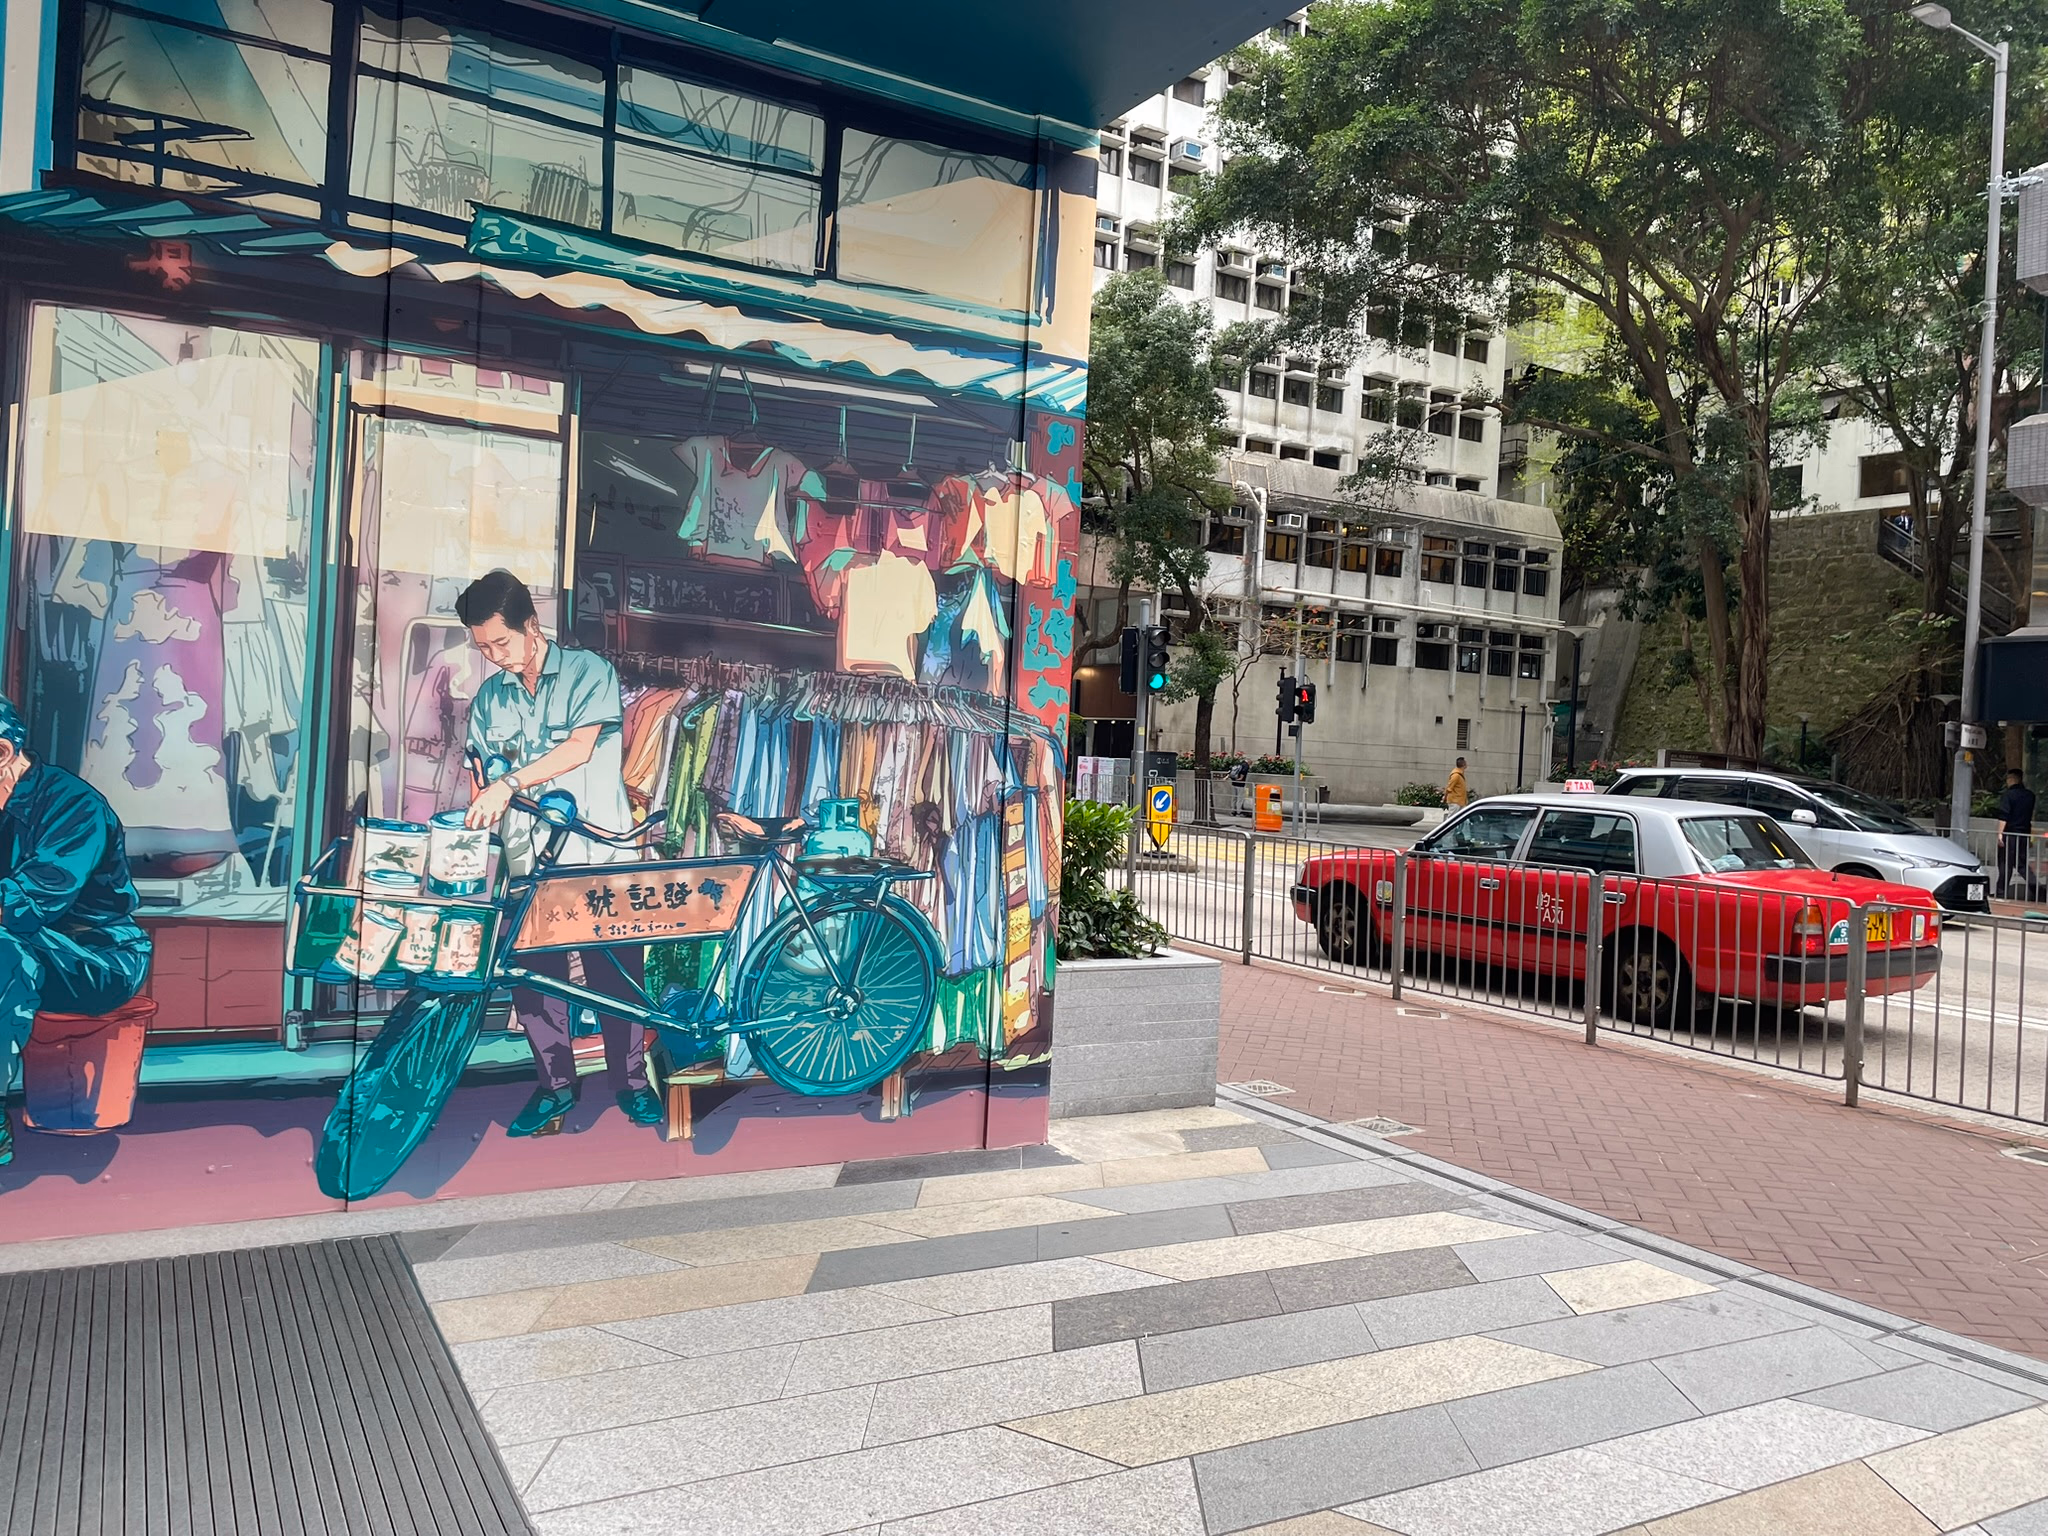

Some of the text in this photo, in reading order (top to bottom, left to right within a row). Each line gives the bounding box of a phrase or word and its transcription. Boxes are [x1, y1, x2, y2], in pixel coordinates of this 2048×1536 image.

[1812, 501, 1841, 514] apok
[1574, 781, 1595, 791] TAXI
[1840, 928, 1847, 938] 5
